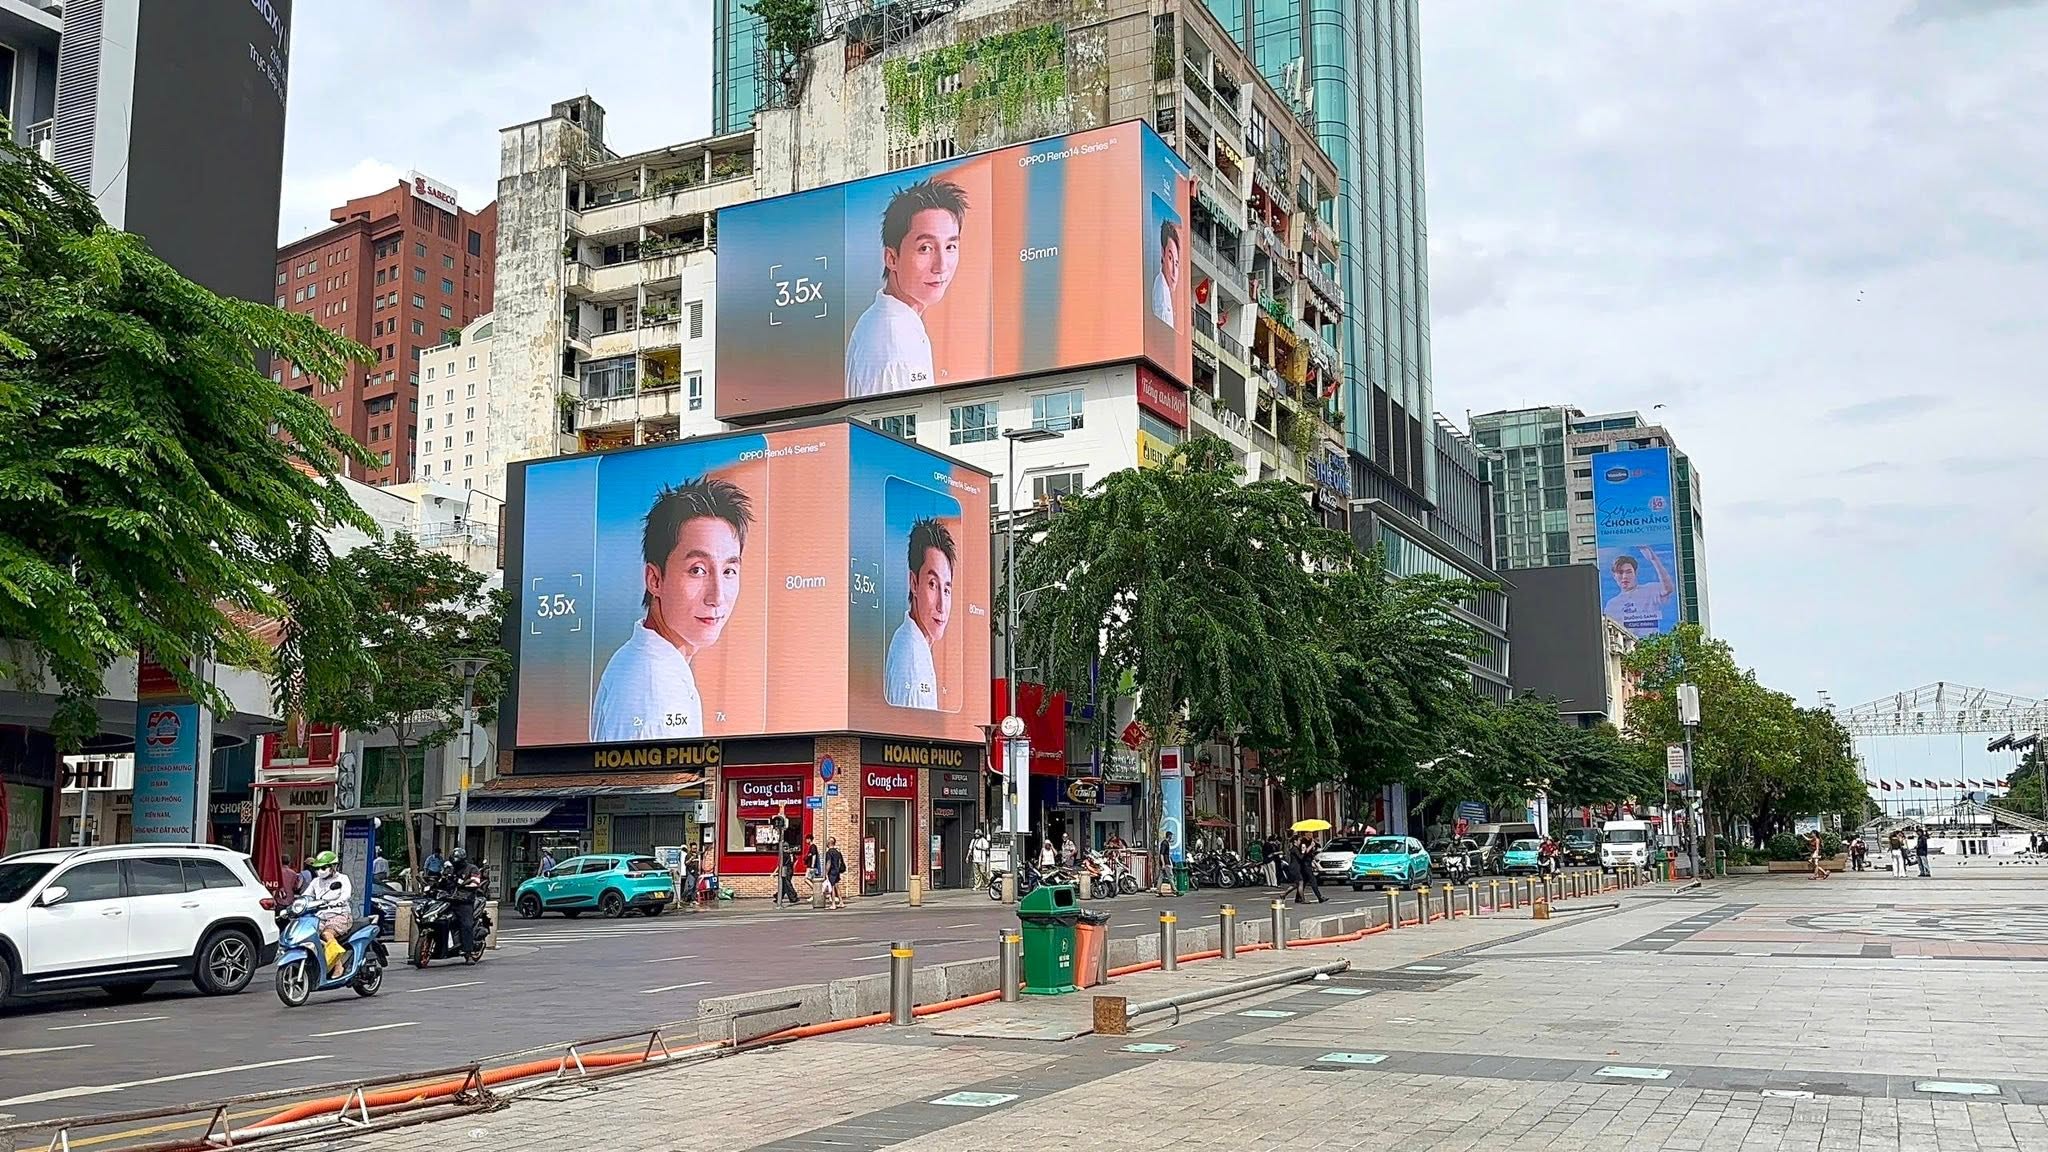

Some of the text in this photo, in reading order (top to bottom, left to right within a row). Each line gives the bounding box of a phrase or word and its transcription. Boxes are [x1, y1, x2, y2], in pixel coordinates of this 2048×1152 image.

[1018, 153, 1046, 167] OPPO
[1047, 146, 1079, 161] Reno14
[1080, 142, 1109, 154] Series
[427, 186, 456, 206] SABECO
[1269, 182, 1291, 217] LETTER
[1019, 245, 1058, 262] 85mm
[775, 277, 823, 307] 3.5x
[739, 450, 764, 461] OPPO
[764, 446, 793, 458] Reno14
[794, 443, 819, 454] Series
[933, 471, 947, 484] OPPO
[785, 575, 826, 590] 80mm
[537, 593, 576, 619] 3,5x
[665, 713, 688, 727] 3,5x
[715, 711, 726, 722] 7x
[594, 748, 662, 768] HOANG
[884, 744, 963, 767] HOANG PHUC
[743, 782, 773, 797] Gong
[774, 781, 793, 793] cha
[867, 772, 908, 791] Gong cha
[290, 790, 328, 806] MAROU
[740, 798, 769, 807] Brewing
[597, 816, 607, 825] 97
